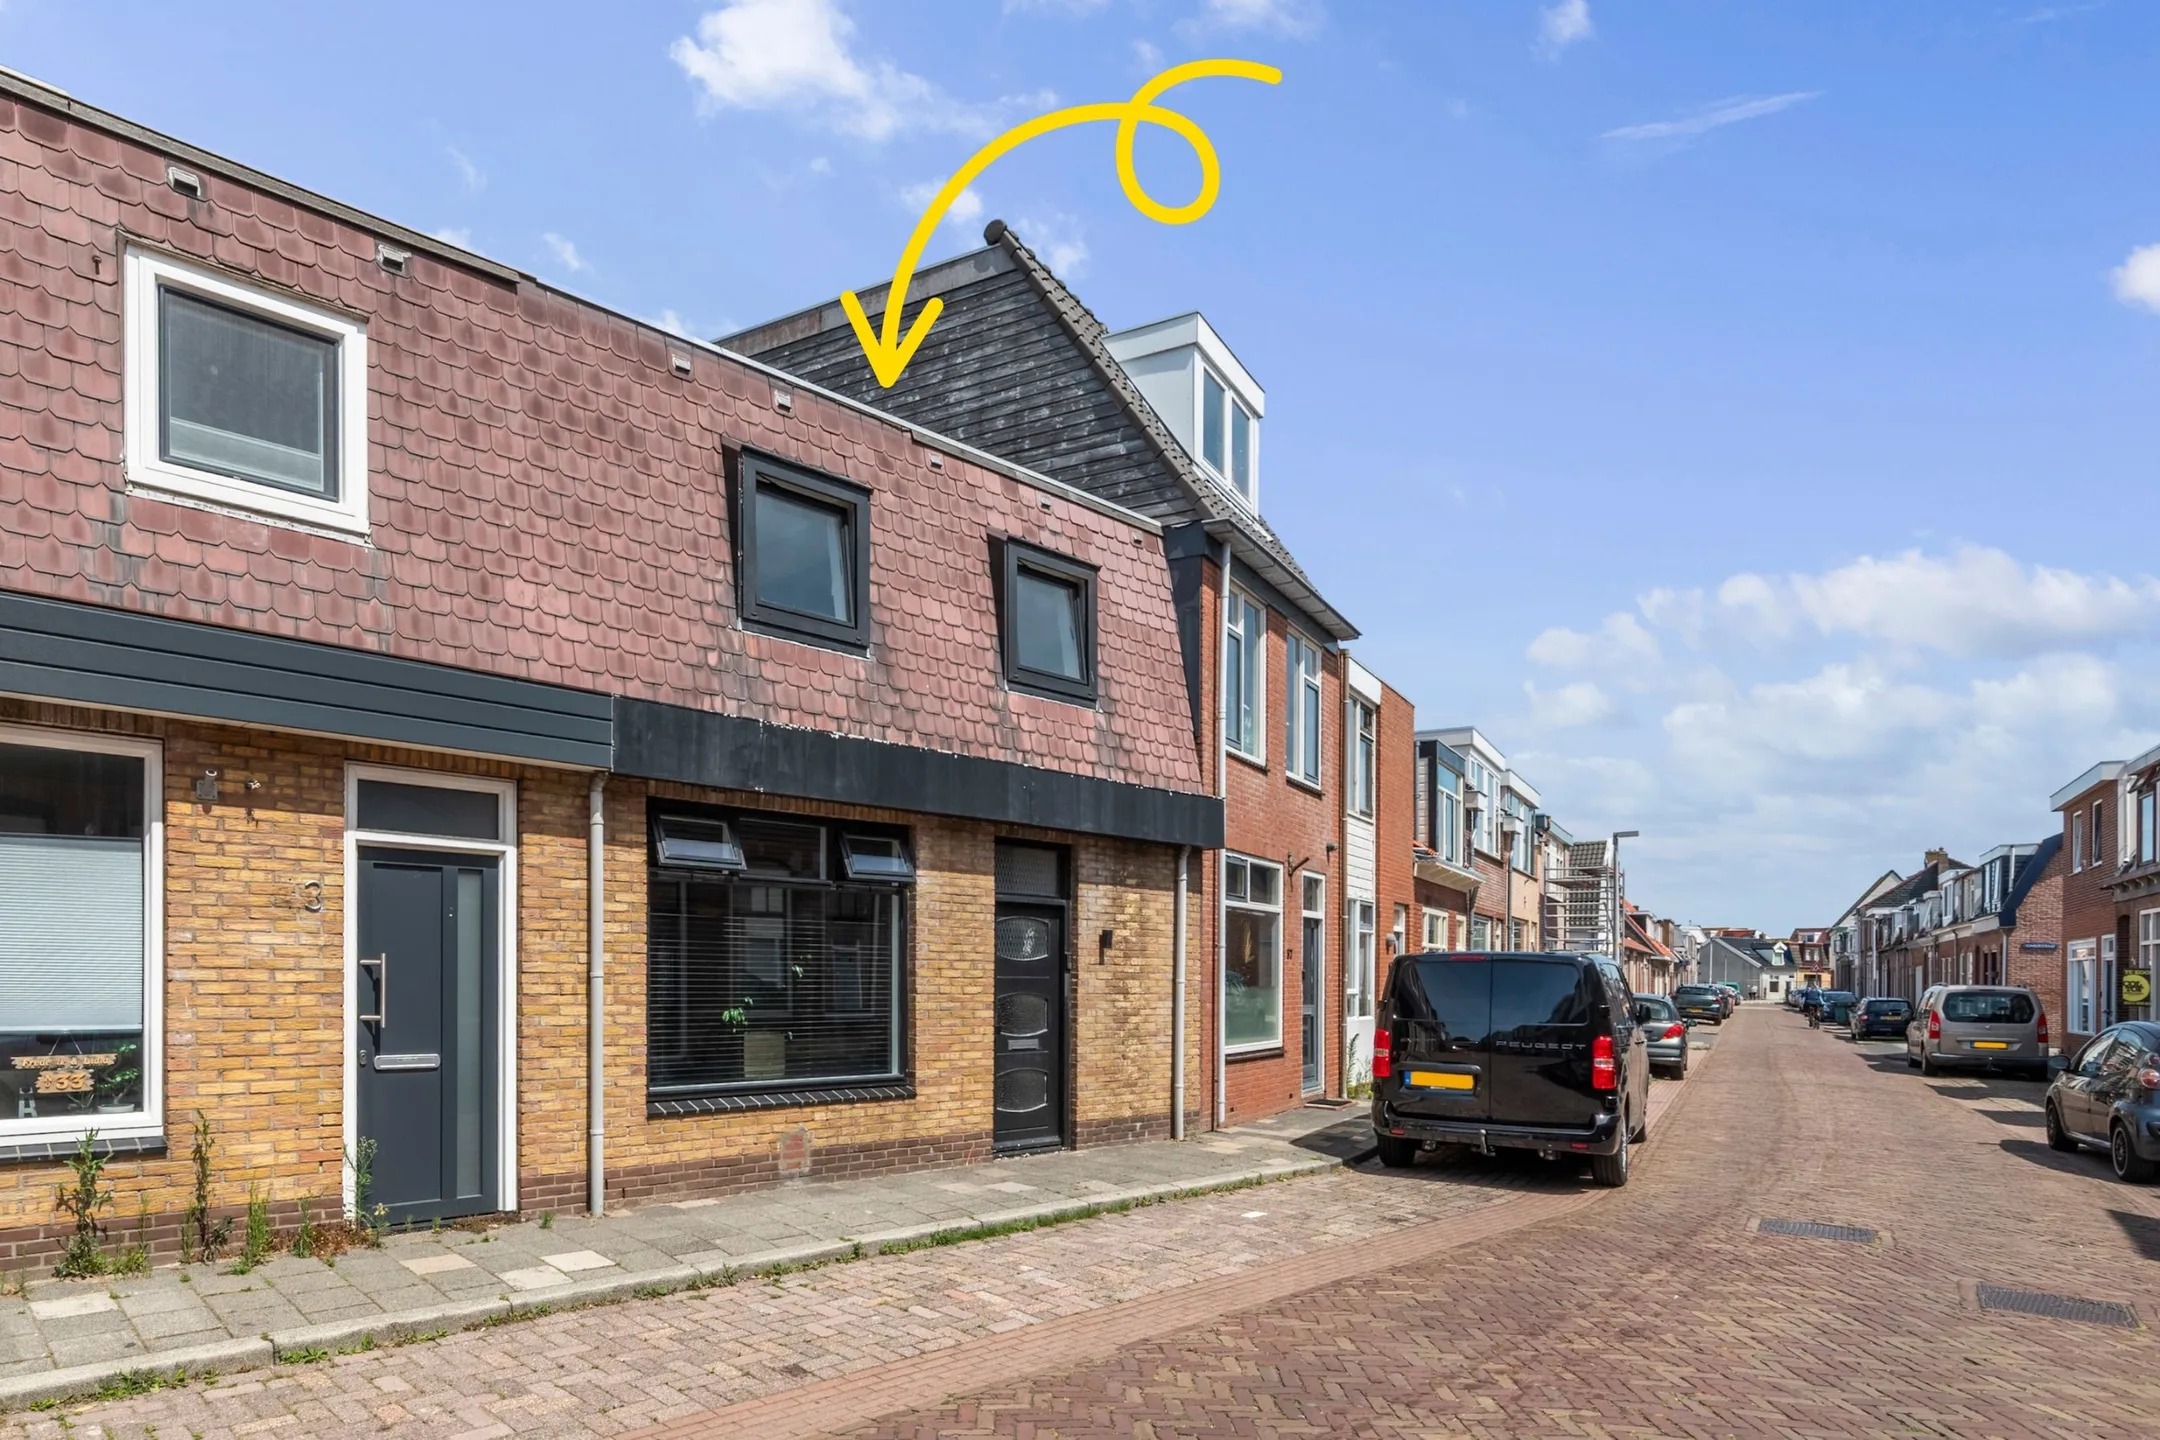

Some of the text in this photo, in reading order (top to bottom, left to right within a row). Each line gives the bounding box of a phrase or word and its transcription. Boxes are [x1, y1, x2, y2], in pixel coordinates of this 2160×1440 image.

[304, 880, 321, 913] 3
[1496, 1040, 1586, 1050] PEUGEOT
[55, 1074, 86, 1091] 33
